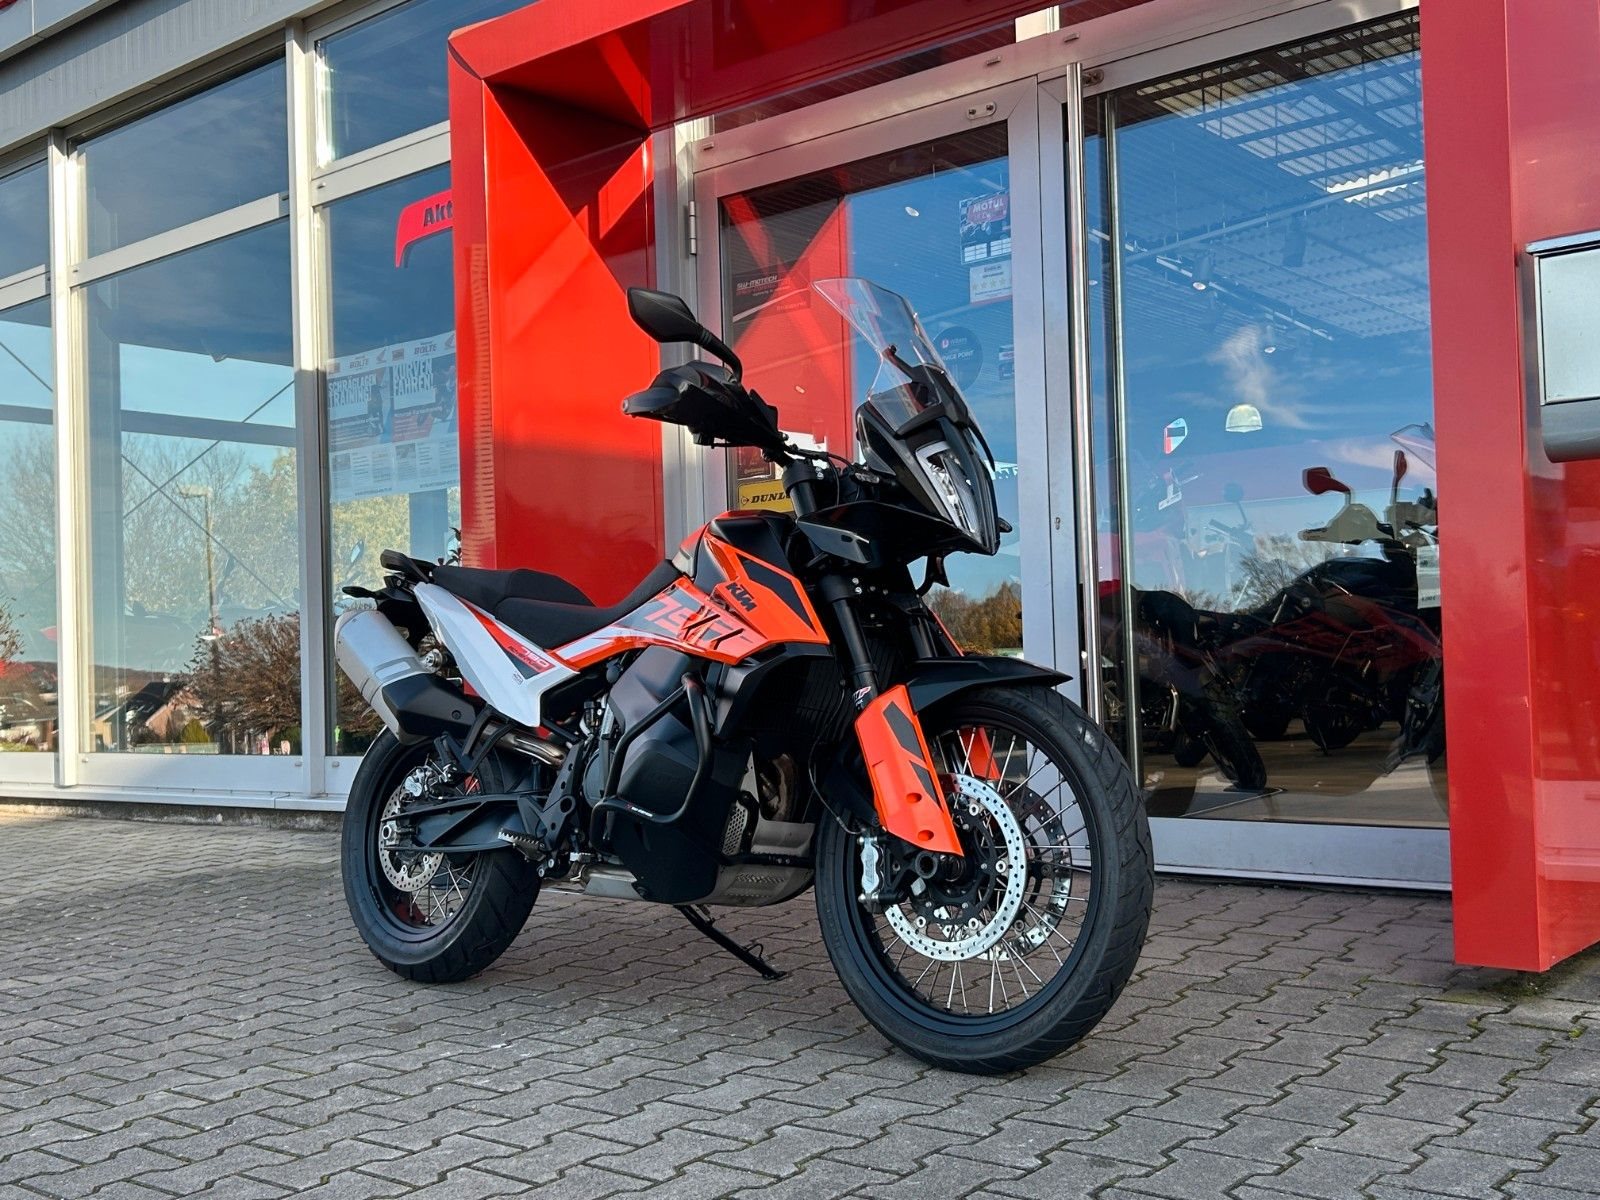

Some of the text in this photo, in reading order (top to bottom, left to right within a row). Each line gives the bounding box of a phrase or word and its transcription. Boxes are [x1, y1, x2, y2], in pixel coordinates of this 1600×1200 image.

[973, 199, 1004, 214] MOTUL
[751, 492, 790, 503] DUNL
[726, 582, 757, 611] KTM
